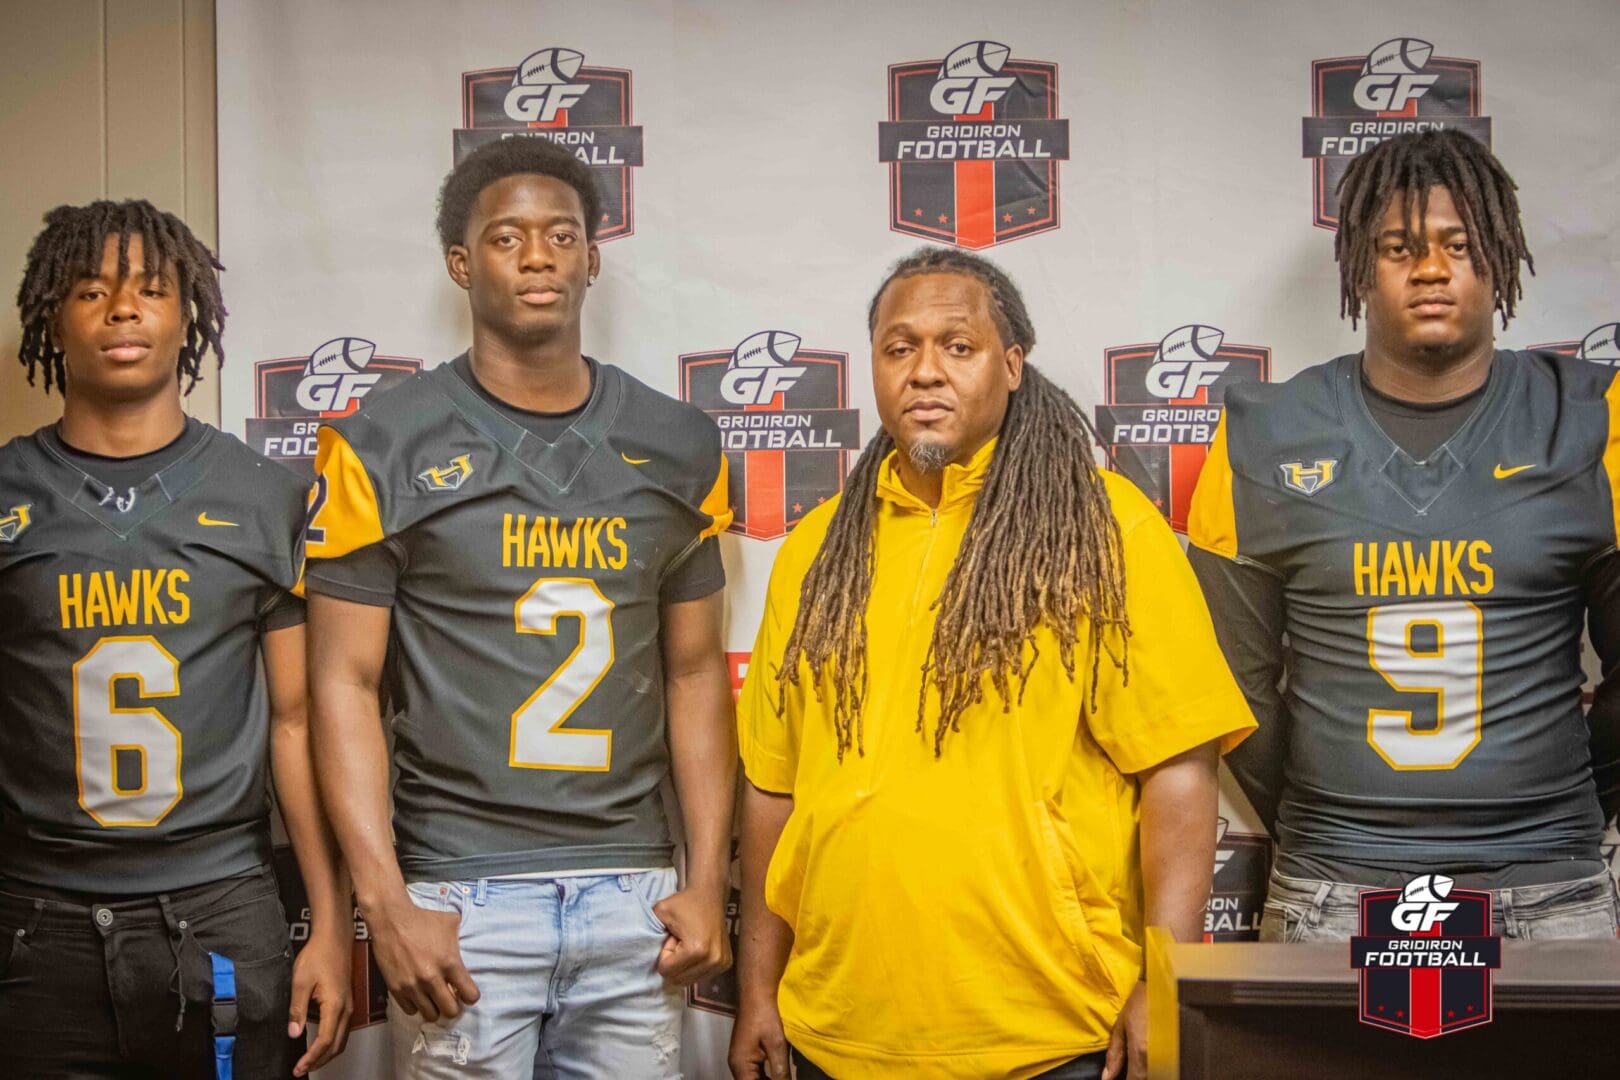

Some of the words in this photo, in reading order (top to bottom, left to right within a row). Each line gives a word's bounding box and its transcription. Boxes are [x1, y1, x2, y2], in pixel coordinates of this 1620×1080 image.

[503, 84, 590, 121] GF
[930, 77, 1016, 114] GF
[1353, 74, 1439, 110] GF
[897, 139, 1051, 159] FOOTBALL
[927, 125, 1021, 138] GRIDIRON
[296, 374, 381, 411] GF
[720, 367, 807, 404] GF
[1145, 361, 1230, 398] GF
[717, 415, 812, 428] GRIDIRON
[1142, 409, 1220, 422] GRIDIRO
[502, 513, 628, 570] HAWKS
[1353, 540, 1494, 595] HAWKS
[58, 568, 190, 629] HAWKS
[509, 577, 615, 772] 2
[1367, 600, 1484, 771] 9
[72, 635, 183, 827] 6
